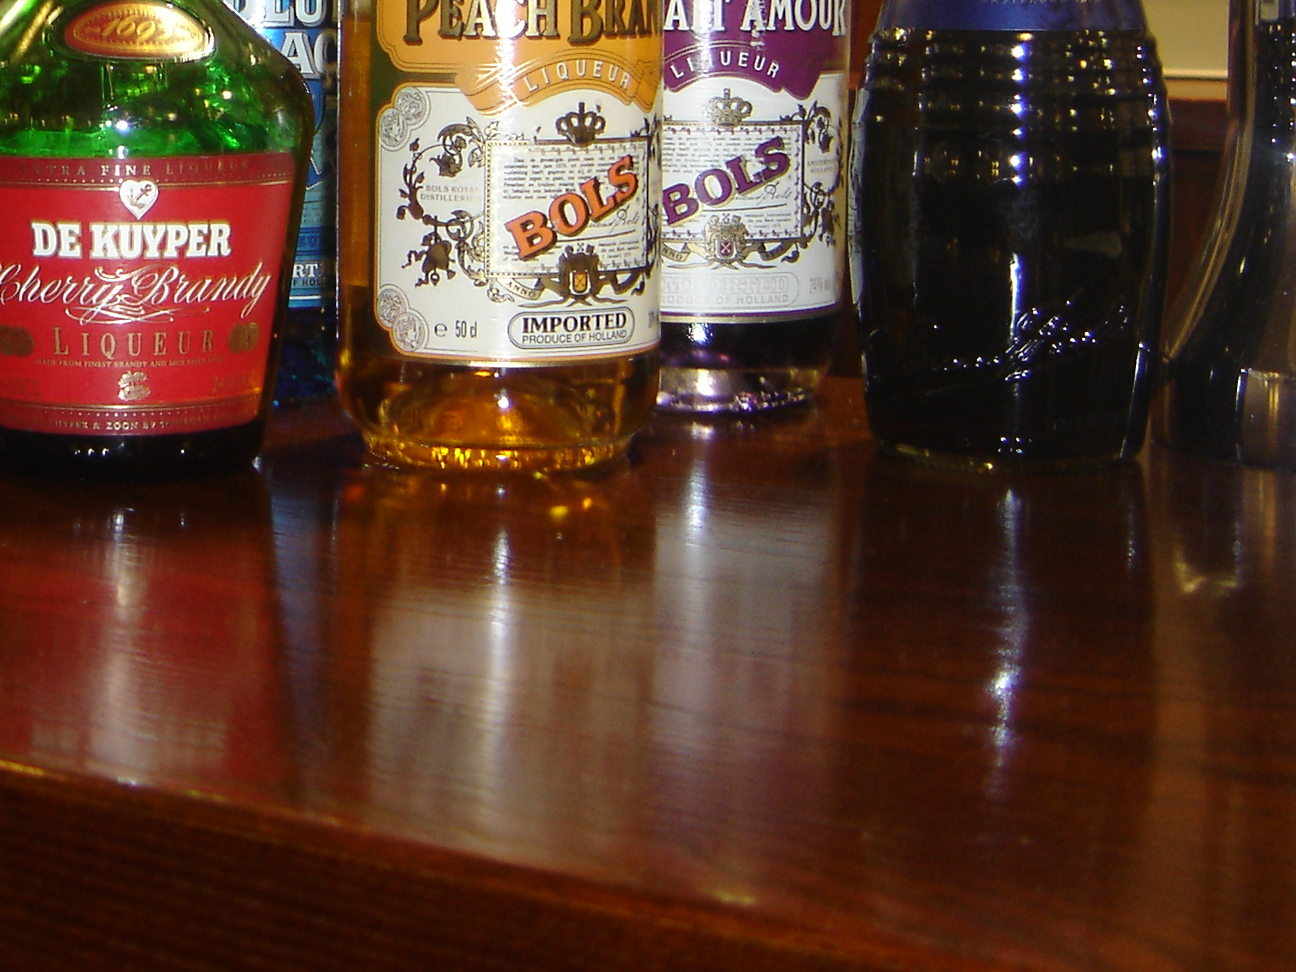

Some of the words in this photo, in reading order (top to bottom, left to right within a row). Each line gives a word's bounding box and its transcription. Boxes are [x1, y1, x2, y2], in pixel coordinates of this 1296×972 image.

[524, 59, 631, 94] LIQUEUR
[670, 50, 780, 80] LIUEUR
[101, 164, 151, 176] FINE
[663, 136, 792, 227] BOLS
[504, 154, 640, 262] BOLS
[31, 220, 83, 258] DE
[89, 220, 232, 259] KUYPER
[128, 261, 272, 319] Brandy
[736, 294, 789, 305] HOLLAND
[455, 320, 467, 338] 50
[522, 312, 627, 334] IMPORTED
[53, 326, 215, 360] LIQUEUR
[522, 333, 573, 344] PRODUCE
[574, 332, 586, 343] OF
[589, 329, 628, 341] HOLLAND
[84, 360, 111, 368] FINEST
[106, 421, 138, 431] ZOON
